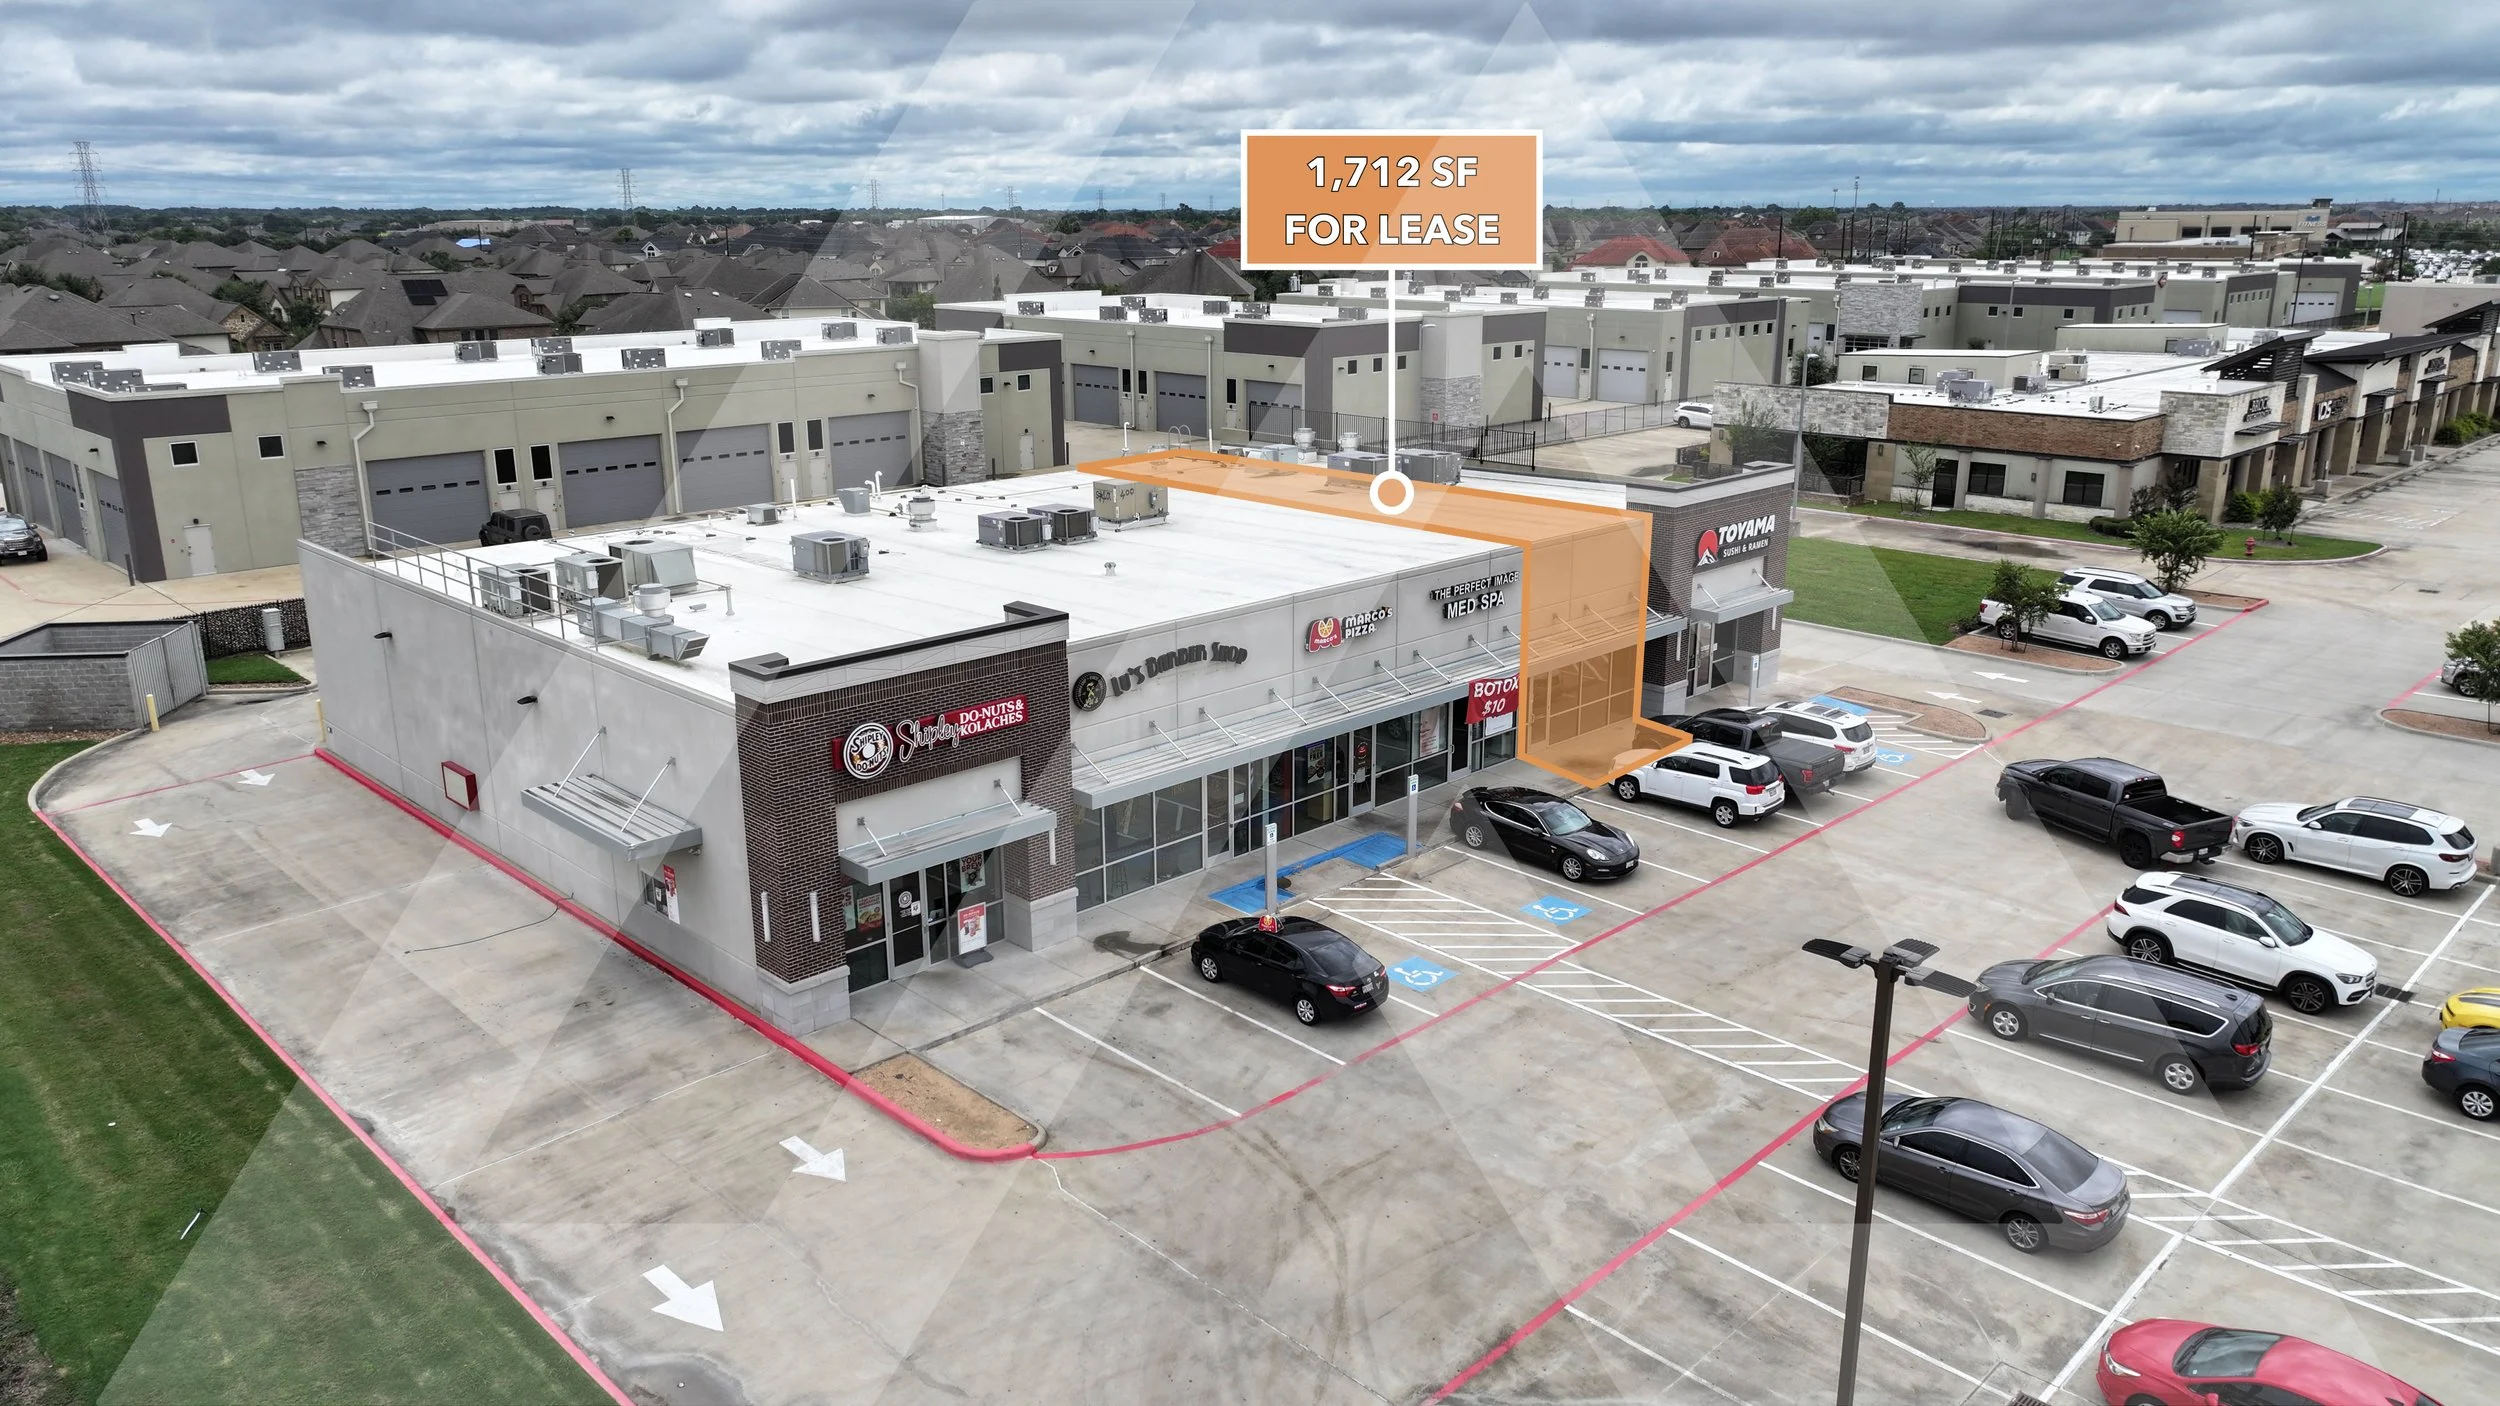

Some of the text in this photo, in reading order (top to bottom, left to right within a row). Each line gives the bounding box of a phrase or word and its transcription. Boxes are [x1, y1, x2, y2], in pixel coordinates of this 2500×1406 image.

[1120, 488, 1134, 500] 400
[1719, 515, 1775, 545] TOYAMA
[1723, 539, 1769, 558] SUSHI & RAMEN
[1433, 571, 1519, 600] THE PERFECT IMAGE
[1447, 591, 1504, 619] MED SPA
[1345, 607, 1393, 627] MARCO'S
[1314, 634, 1337, 643] MARCO'S
[1345, 623, 1376, 639] PIZZA
[1474, 677, 1518, 697] BOTOX
[960, 699, 1024, 724] DO-NUTS &
[1484, 698, 1506, 714] $10
[960, 710, 1023, 736] KOLACHES
[851, 732, 884, 753] SHIPLEY
[896, 714, 961, 762] Shipley
[961, 853, 982, 865] YOUR
